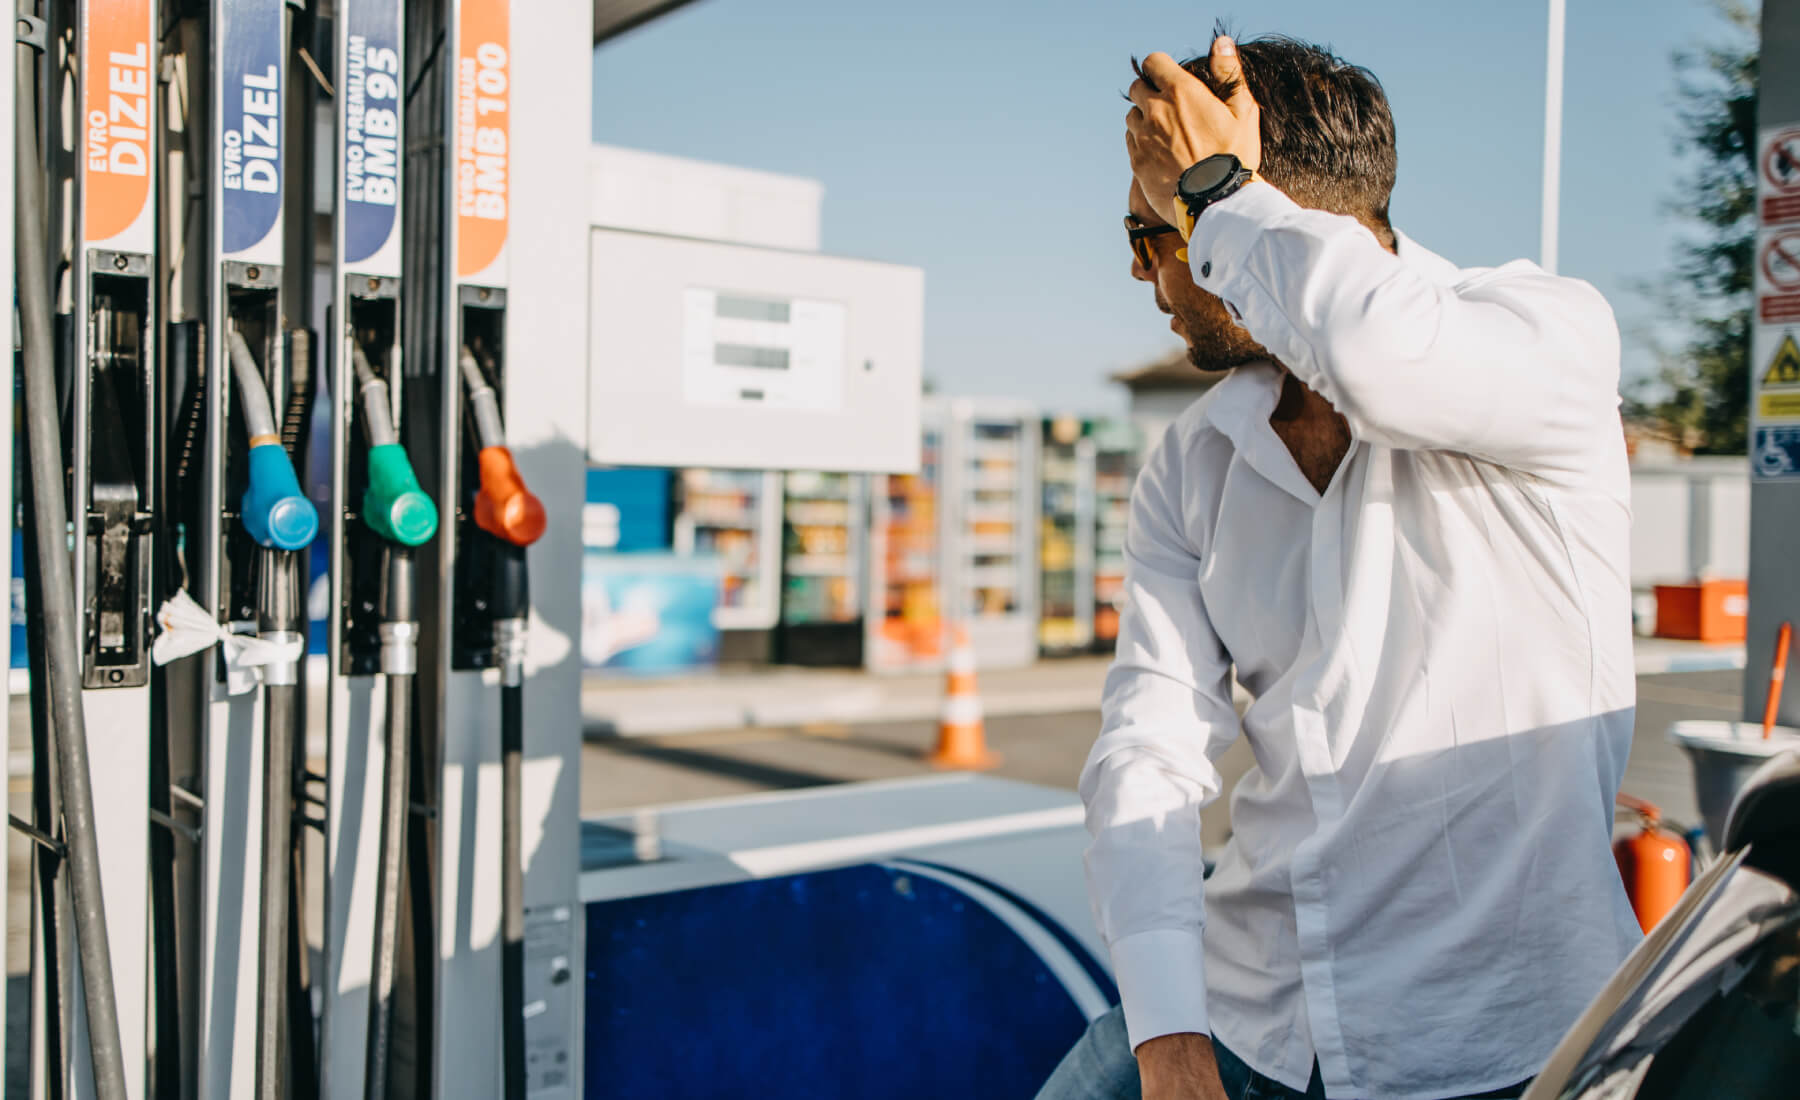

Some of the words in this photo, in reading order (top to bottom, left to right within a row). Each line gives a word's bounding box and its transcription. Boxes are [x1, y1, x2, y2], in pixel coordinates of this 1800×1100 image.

[109, 42, 146, 176] DIZEL
[366, 47, 398, 99] 95
[477, 42, 507, 116] 100
[89, 109, 107, 172] EVRO
[224, 129, 241, 190] EVRO
[243, 64, 278, 194] DIZEL
[364, 107, 397, 206] BMB
[347, 144, 365, 202] EVRO
[475, 127, 506, 220] BMB
